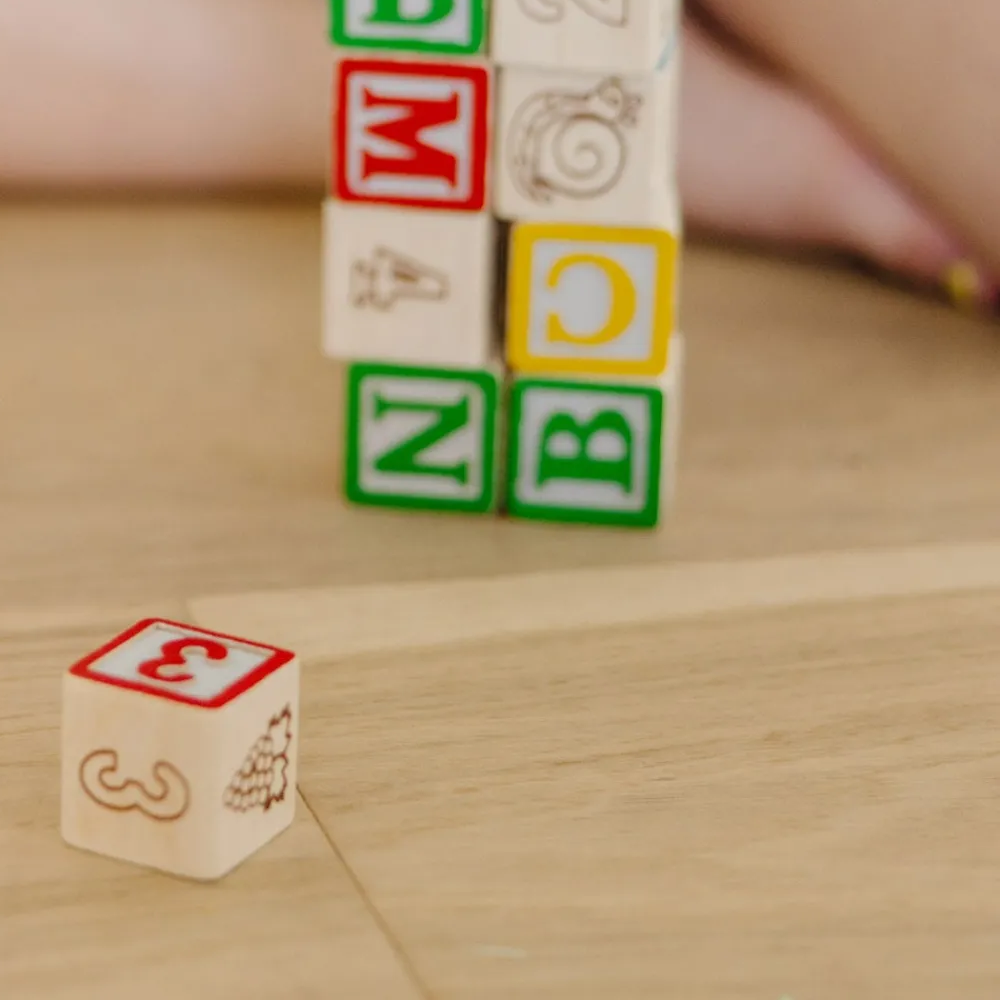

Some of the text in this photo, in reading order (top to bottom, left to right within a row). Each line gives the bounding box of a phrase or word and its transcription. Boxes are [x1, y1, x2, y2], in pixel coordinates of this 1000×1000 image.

[361, 83, 460, 190] M
[544, 253, 637, 347] C
[537, 408, 635, 495] B
[136, 636, 229, 683] 3
[78, 747, 191, 822] 3
